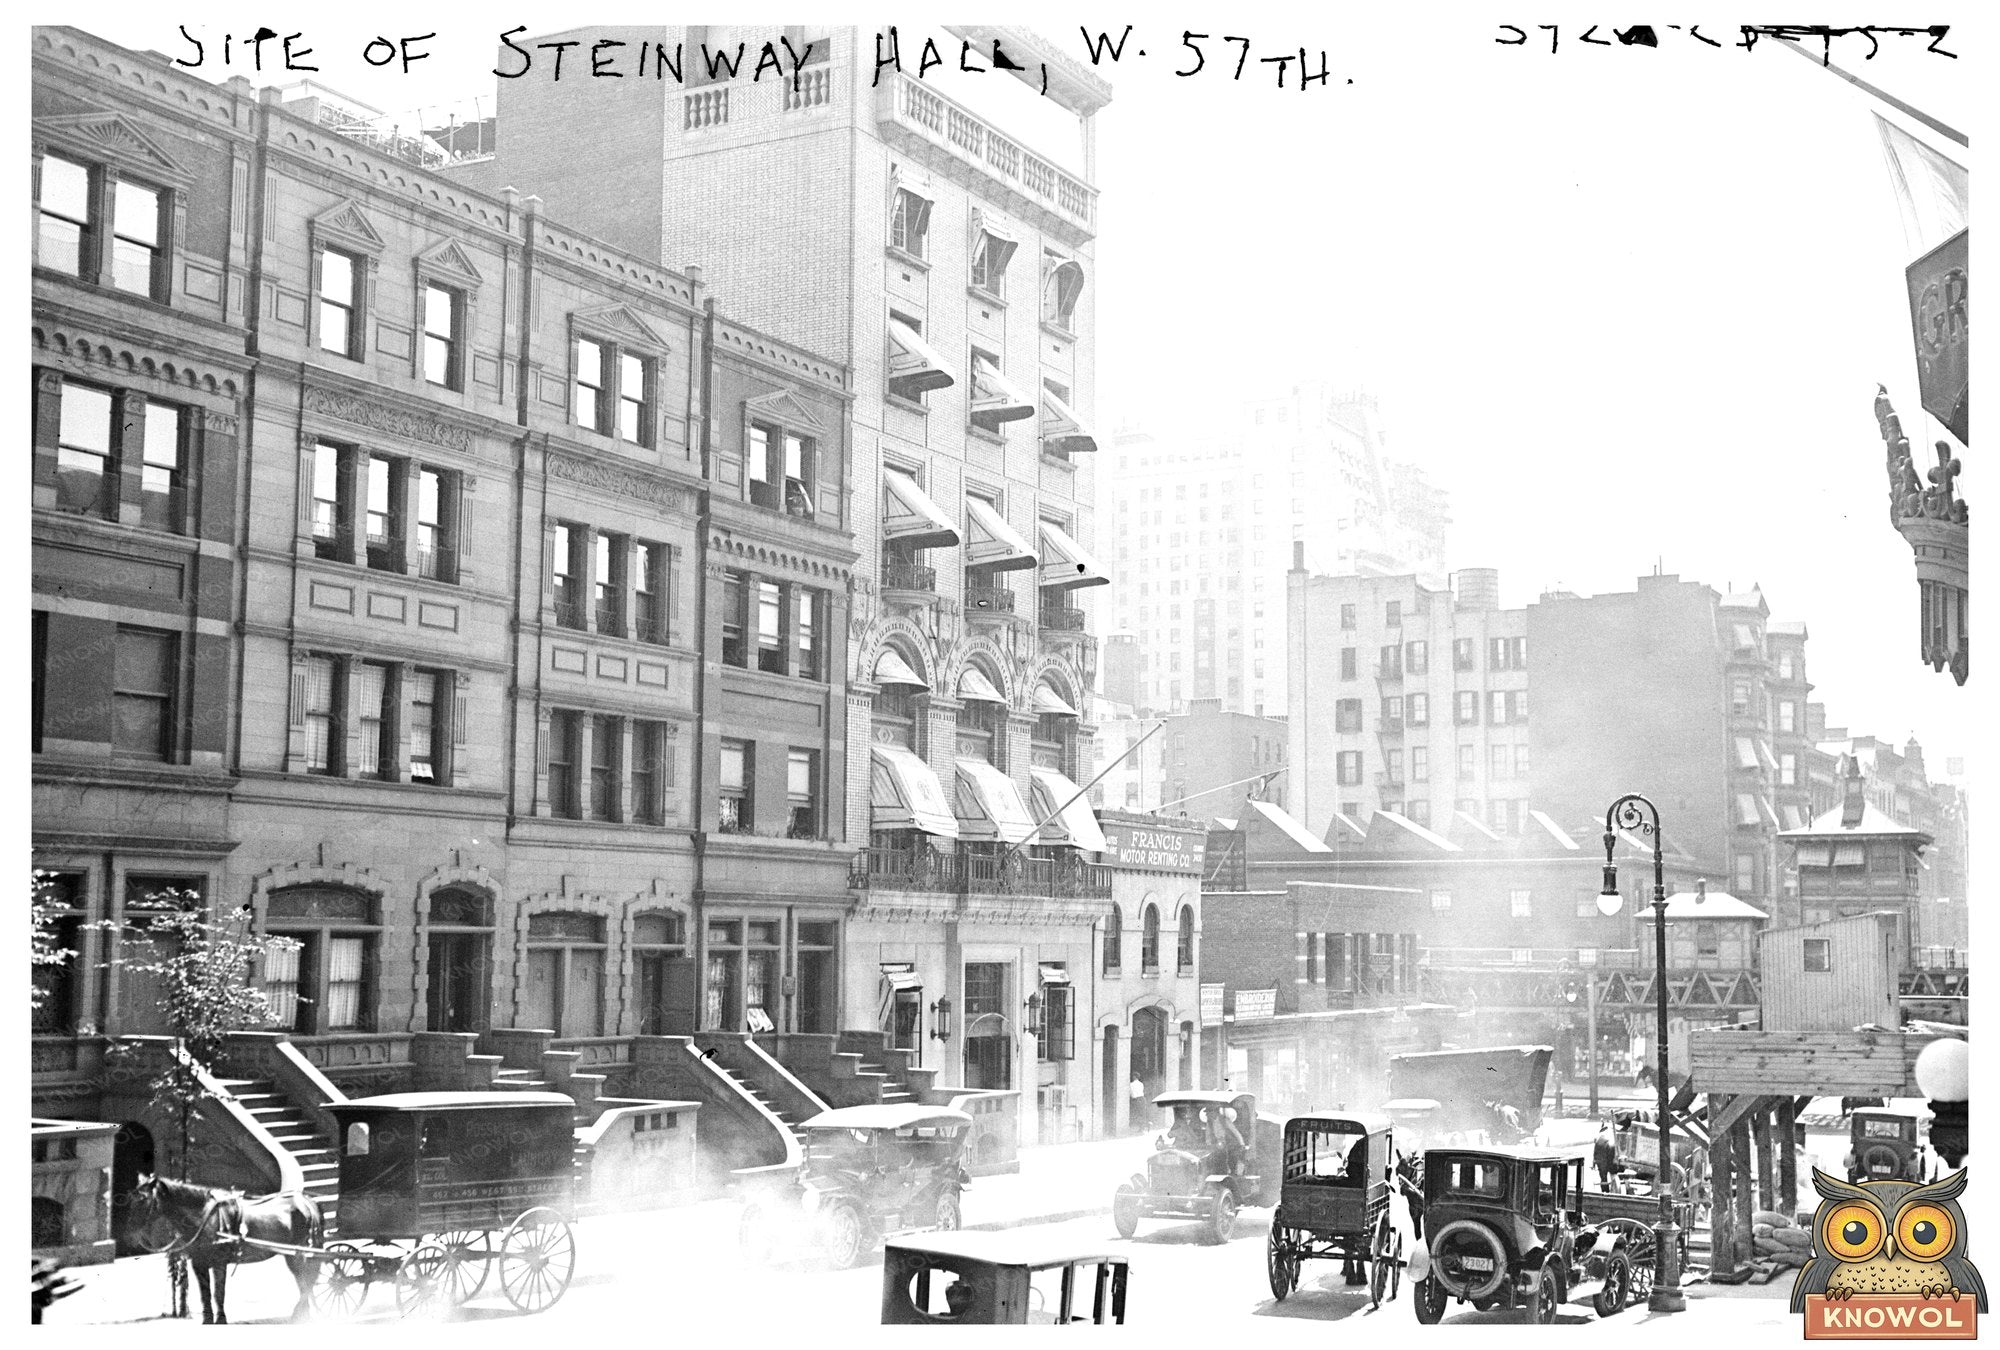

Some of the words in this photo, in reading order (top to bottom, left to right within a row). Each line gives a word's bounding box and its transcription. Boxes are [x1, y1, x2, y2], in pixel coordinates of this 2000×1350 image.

[177, 25, 318, 71] SITE
[363, 33, 436, 73] OF
[492, 26, 812, 92] STEINWAY
[872, 26, 1047, 95] HALL,
[1080, 25, 1145, 65] W.
[1131, 831, 1182, 851] FRANCIS
[1119, 848, 1146, 864] MOTOR
[1147, 850, 1179, 867] RENTING
[1300, 1119, 1352, 1131] FRUITS
